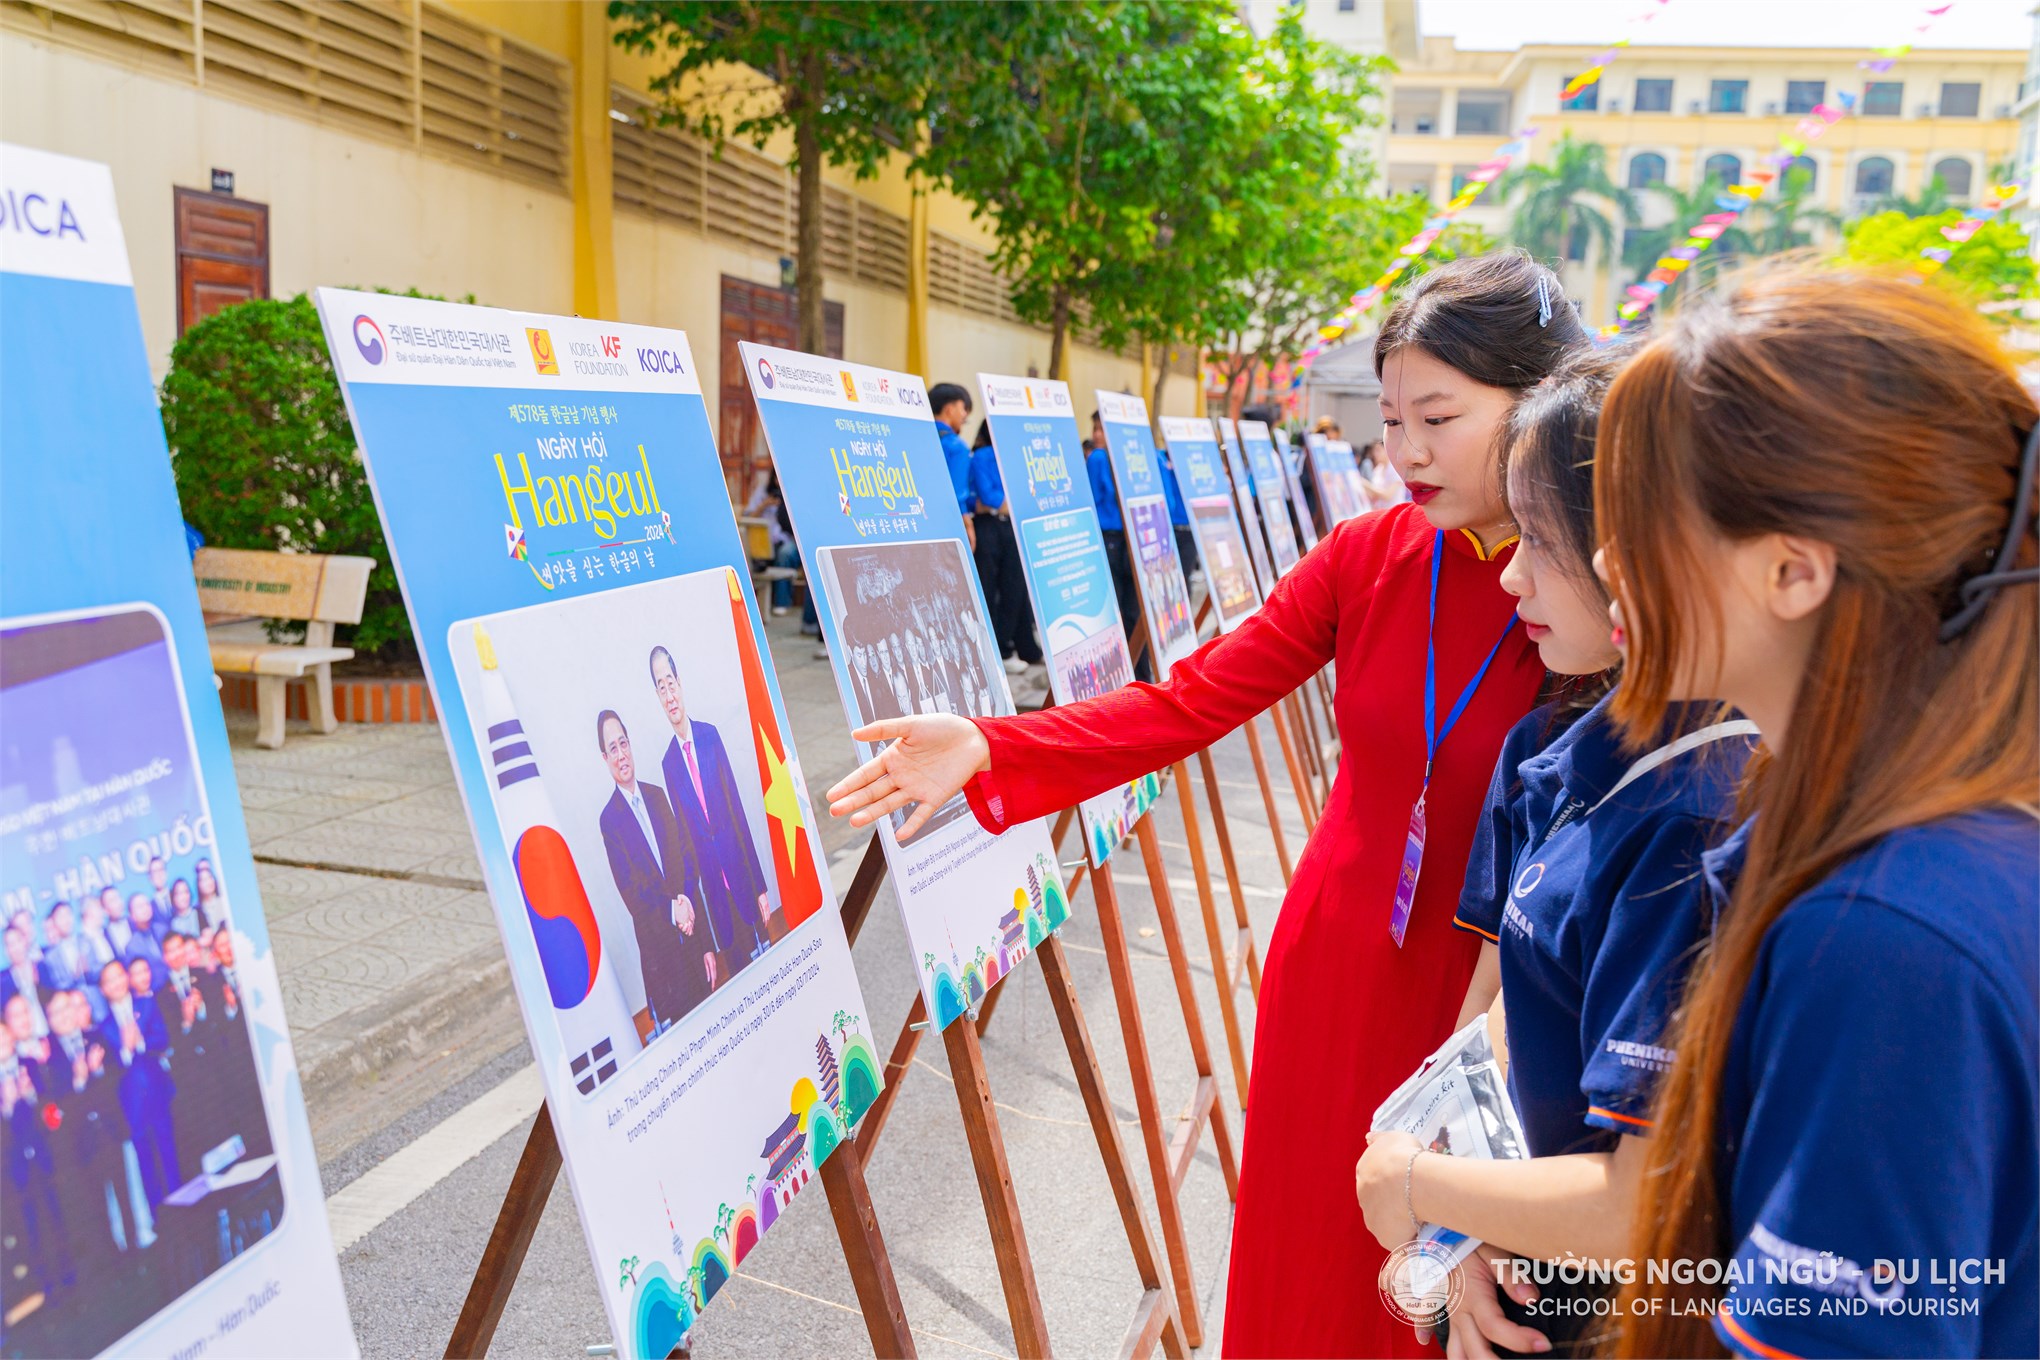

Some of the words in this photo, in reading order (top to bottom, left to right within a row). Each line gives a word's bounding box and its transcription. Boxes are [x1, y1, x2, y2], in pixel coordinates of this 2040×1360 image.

[388, 324, 512, 353] 주베트남대한민국대사관
[569, 342, 600, 357] KOREA
[601, 336, 621, 359] KF
[574, 361, 629, 376] FOUNDATION
[637, 348, 685, 374] KOICA
[897, 387, 924, 407] KOICA
[508, 404, 550, 425] 제578돌
[550, 405, 580, 425] 한글날
[580, 405, 599, 425] 기념
[600, 406, 618, 425] 행사
[536, 432, 578, 460] NGÀY
[580, 431, 609, 462] HỘI
[494, 444, 662, 540] Hangeul
[644, 525, 665, 541] 2024
[583, 555, 604, 580] 심는
[609, 548, 641, 575] 한글의
[644, 546, 655, 569] 날
[54, 850, 126, 900] HÀN
[659, 1060, 678, 1083] Chính
[689, 1035, 708, 1057] Phạm
[706, 1021, 722, 1041] Minh
[720, 1007, 738, 1029] Chính
[801, 942, 814, 961] Duck
[627, 1119, 648, 1143] trong
[762, 1001, 775, 1020] 30/6
